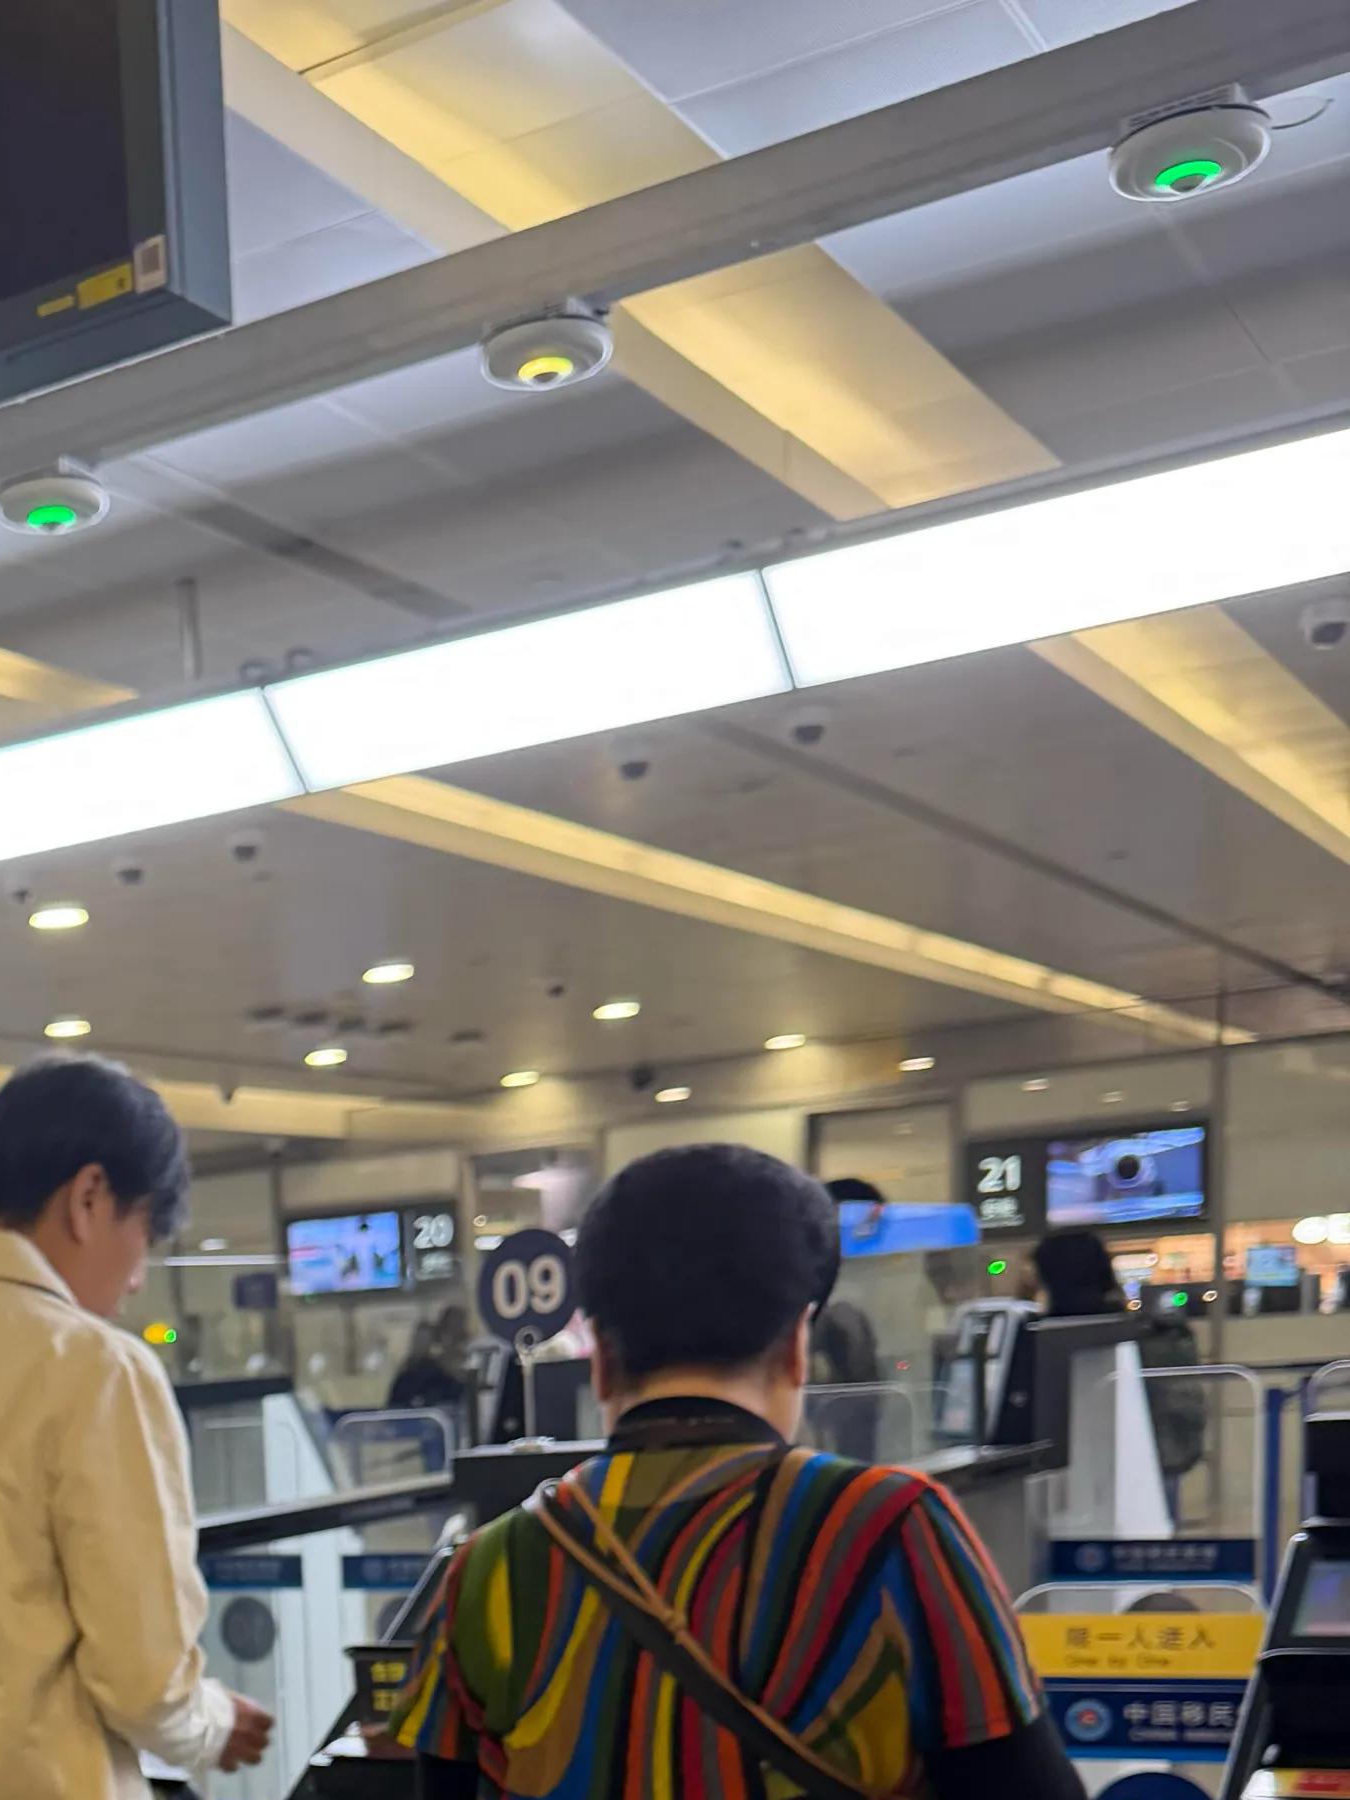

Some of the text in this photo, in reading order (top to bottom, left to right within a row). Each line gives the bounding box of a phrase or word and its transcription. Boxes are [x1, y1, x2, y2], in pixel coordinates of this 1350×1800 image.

[977, 1154, 1021, 1193] 21
[413, 1214, 454, 1249] 20
[492, 1254, 566, 1319] 09
